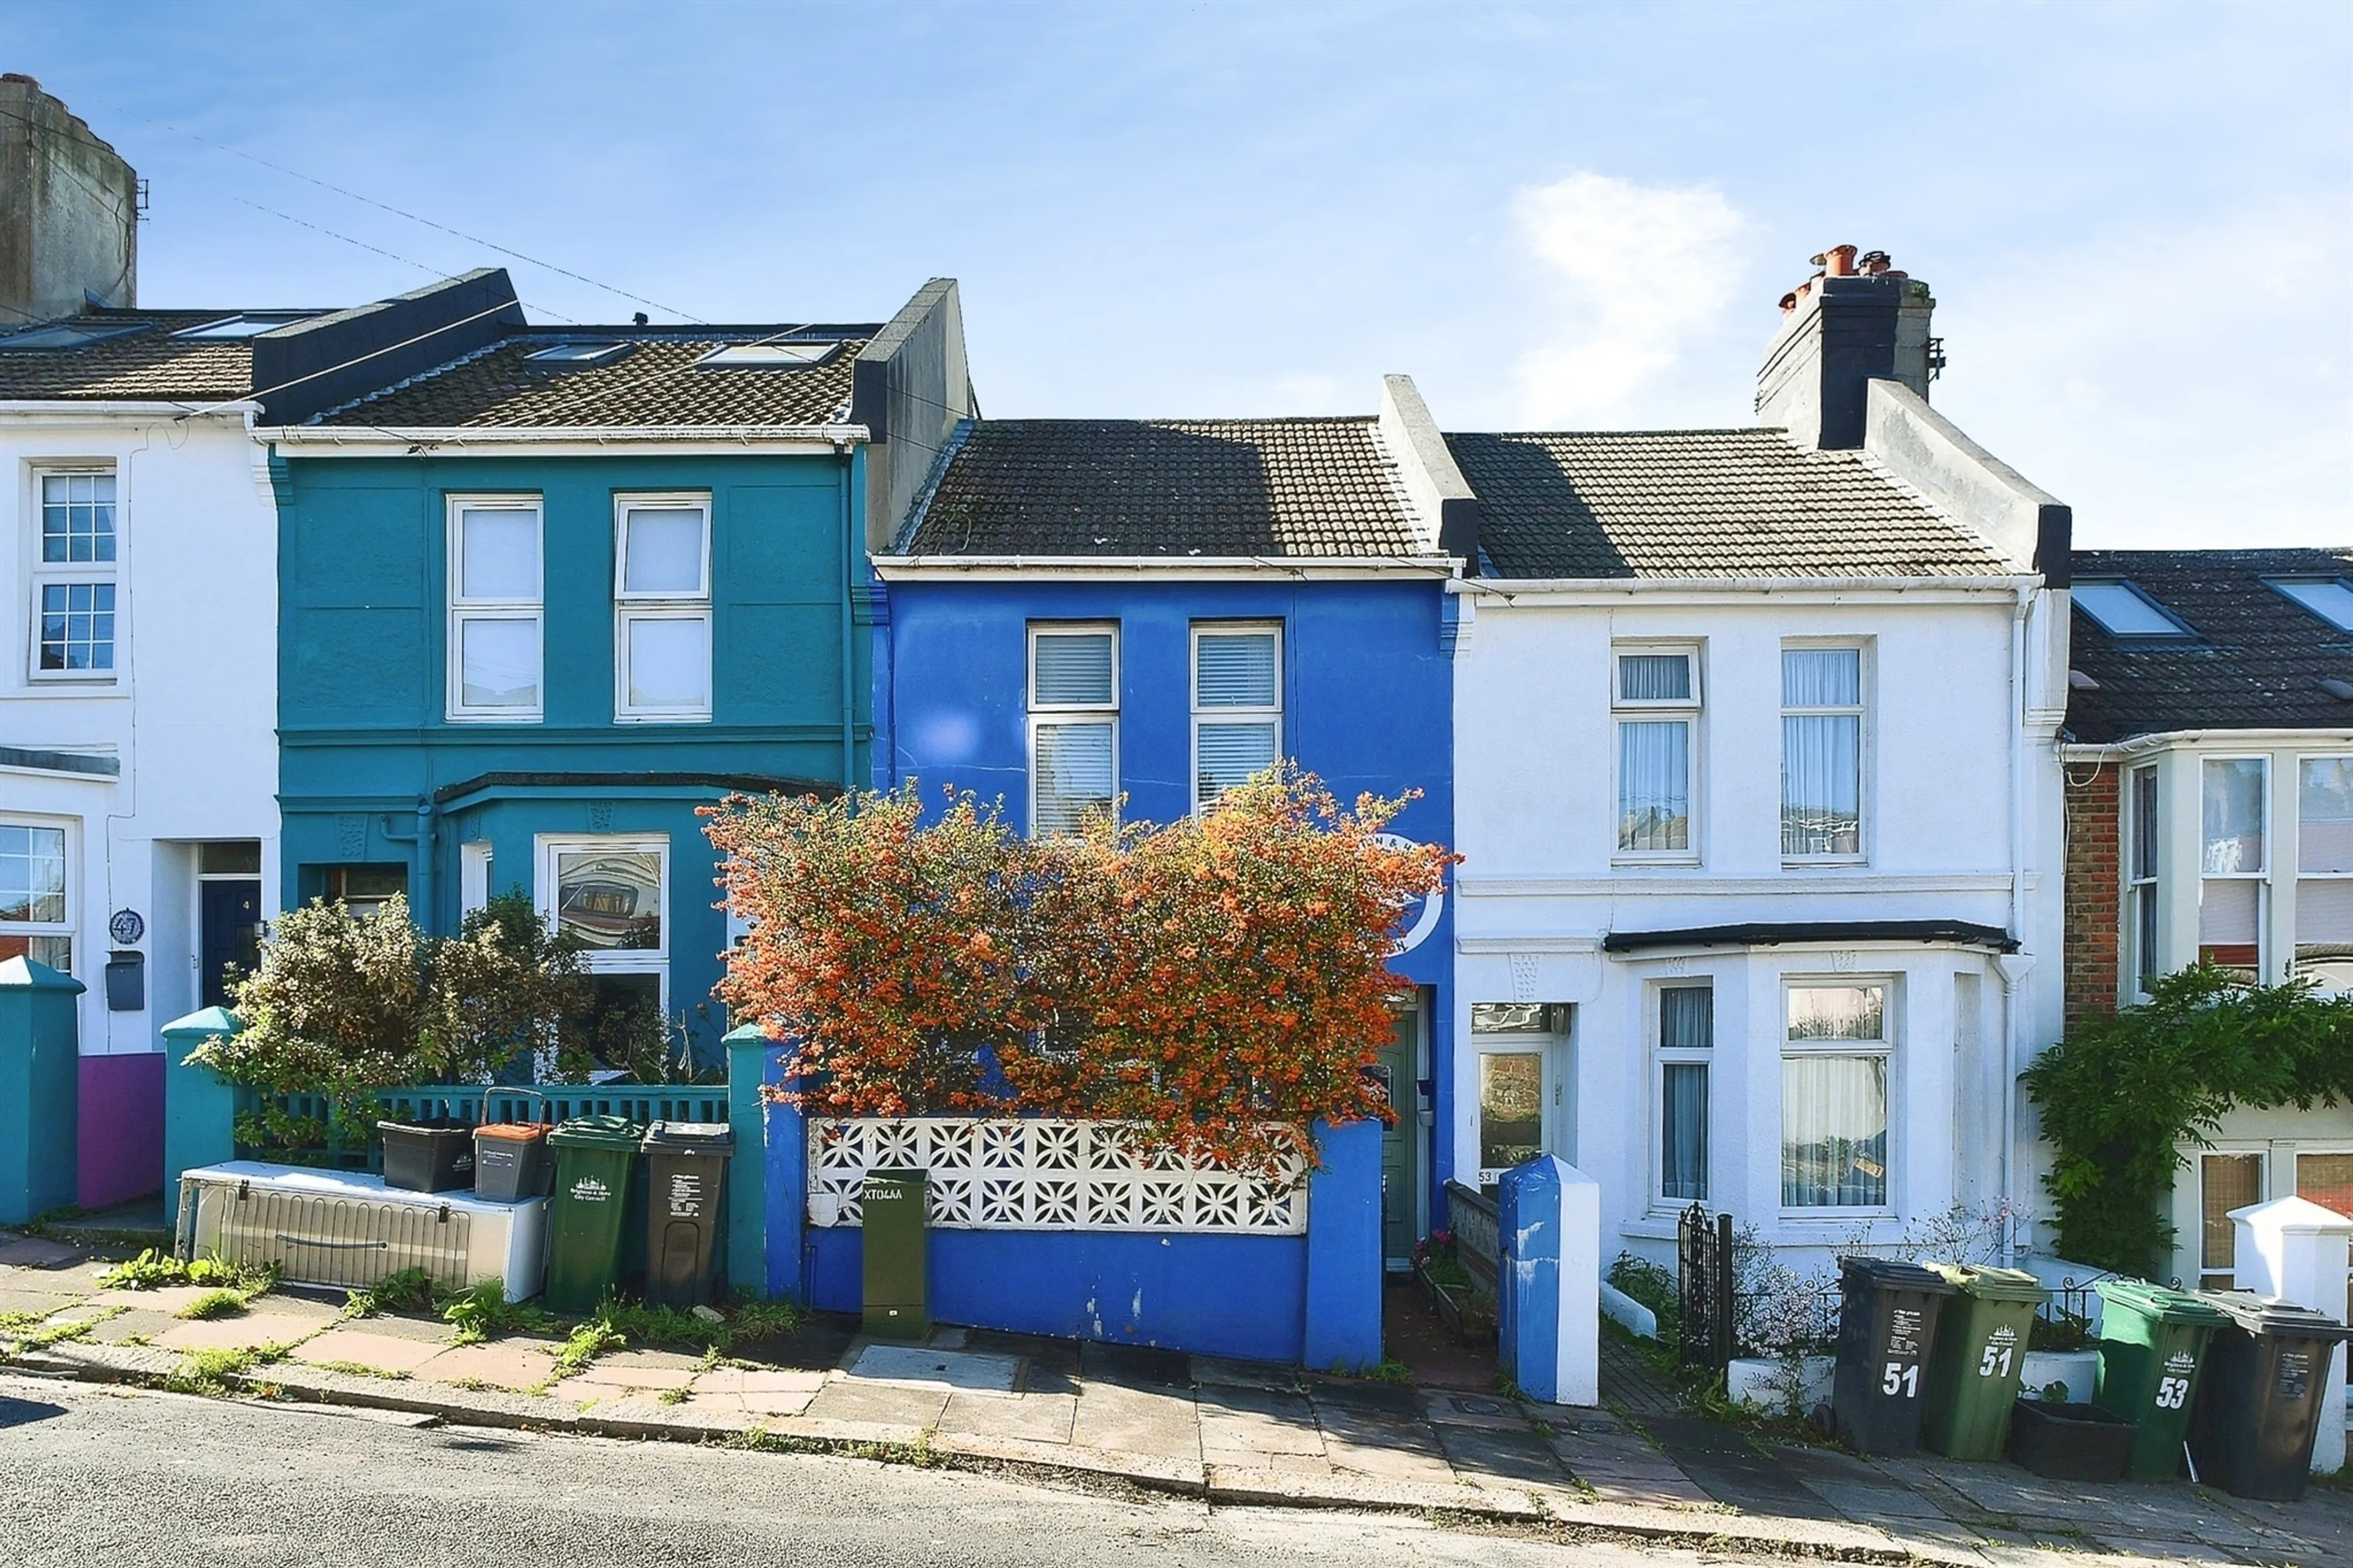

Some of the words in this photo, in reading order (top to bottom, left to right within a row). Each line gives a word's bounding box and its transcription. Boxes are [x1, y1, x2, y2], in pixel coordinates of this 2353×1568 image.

[1389, 838, 1397, 847] &
[113, 917, 136, 935] 47
[1479, 1172, 1491, 1182] 53
[1979, 1346, 2012, 1377] 51
[1883, 1362, 1919, 1397] 51
[2156, 1376, 2189, 1409] 53
